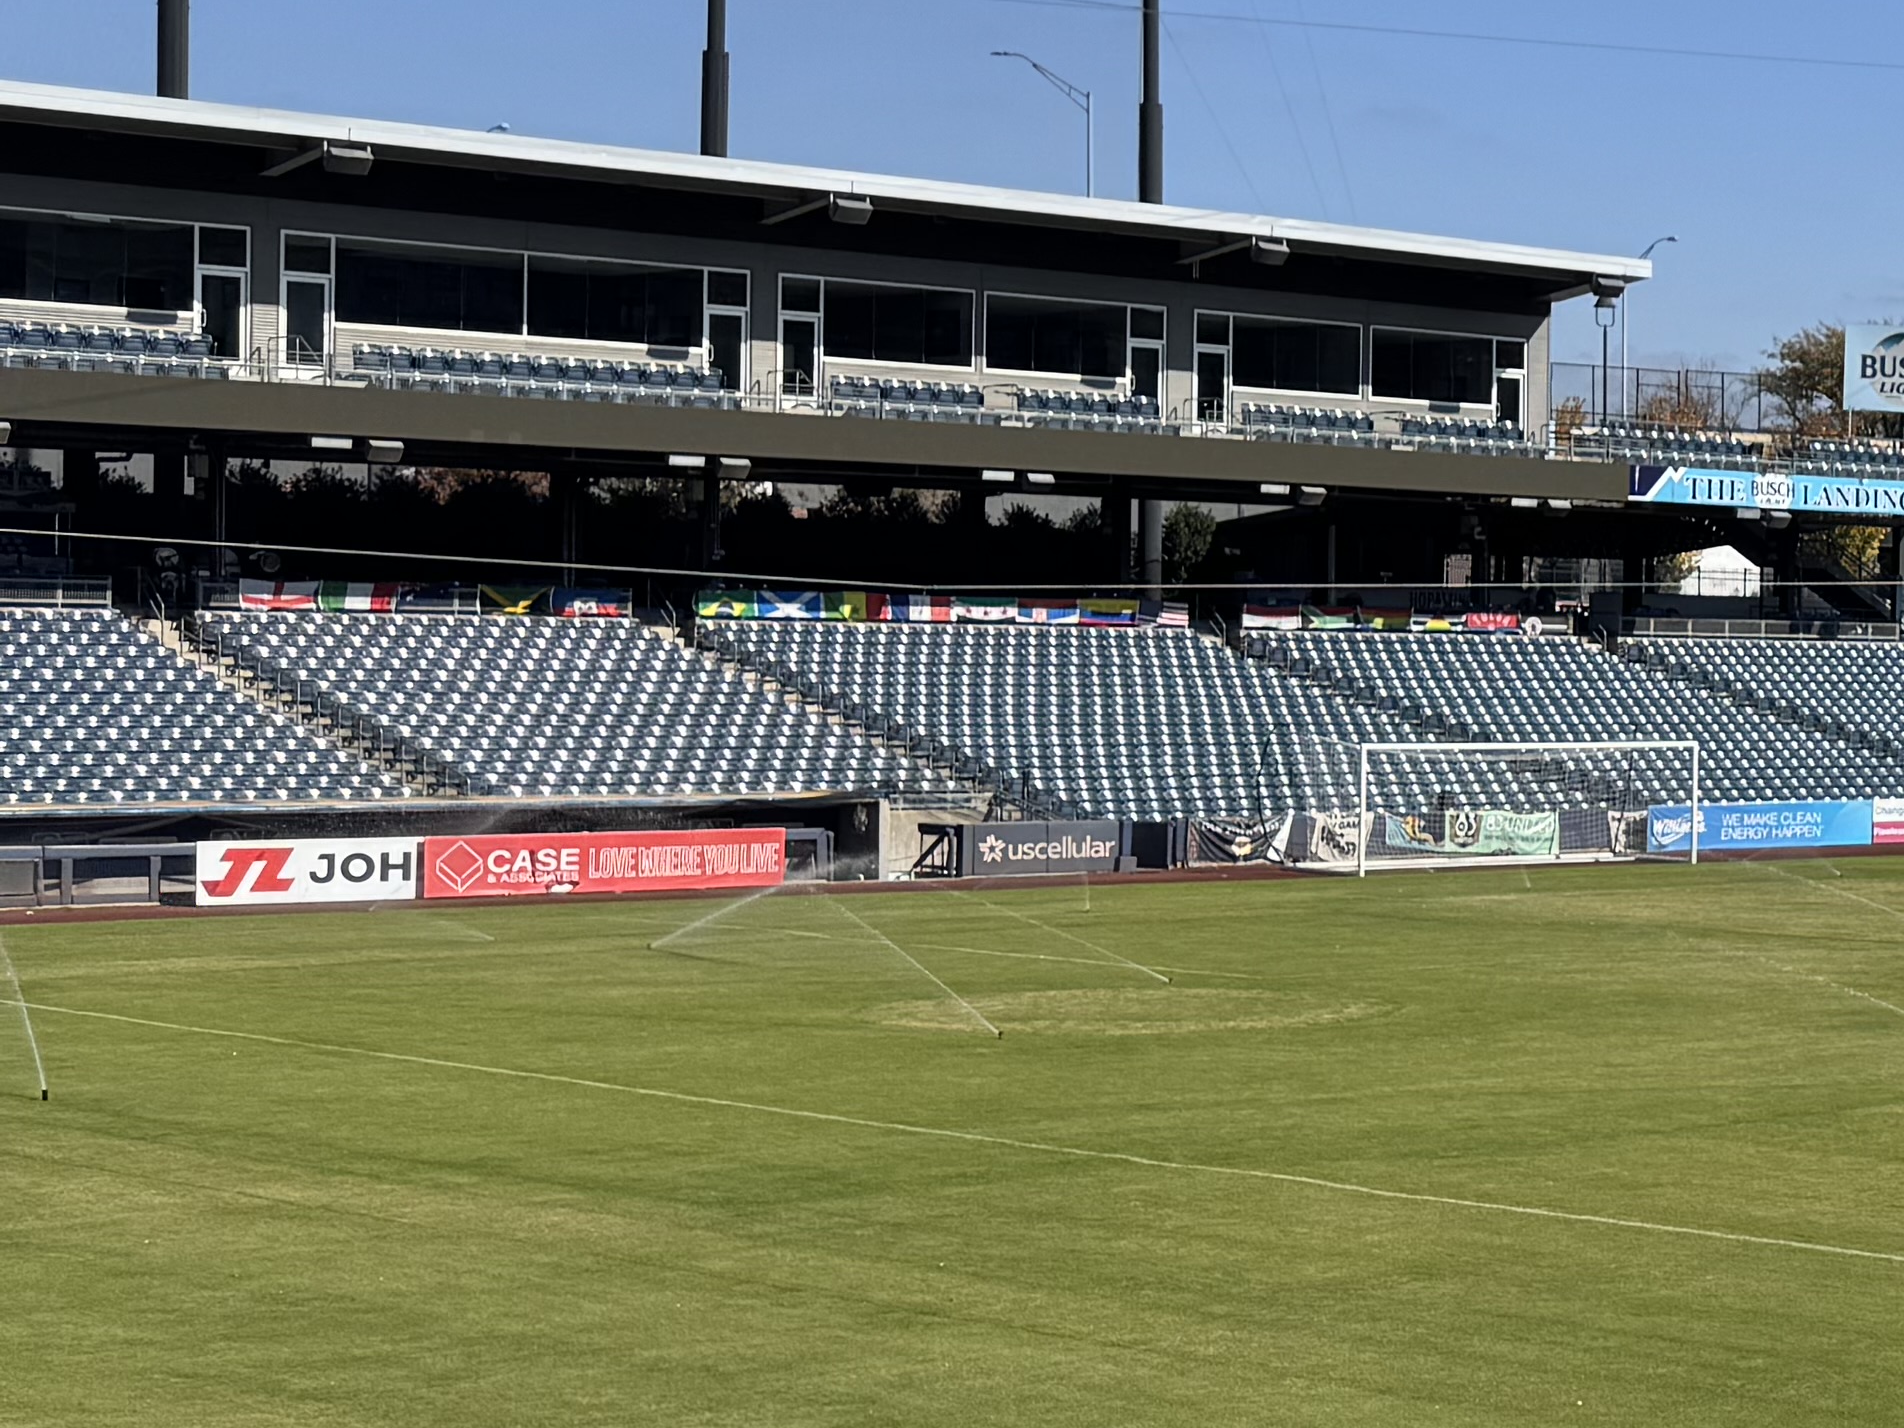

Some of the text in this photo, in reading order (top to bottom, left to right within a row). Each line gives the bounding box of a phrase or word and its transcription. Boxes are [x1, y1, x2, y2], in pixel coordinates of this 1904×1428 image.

[1685, 477, 1745, 502] THE
[1751, 479, 1795, 499] BUSCH
[1721, 813, 1742, 827] WE
[1743, 812, 1778, 826] MAKE
[1780, 811, 1822, 824] CLEAN
[1721, 825, 1823, 841] ENERGY HAPPEN
[487, 847, 580, 873] CASE
[588, 842, 781, 879] LOVE WHERE YOU LIVE
[1008, 835, 1116, 861] uscellular
[309, 852, 412, 884] JOH
